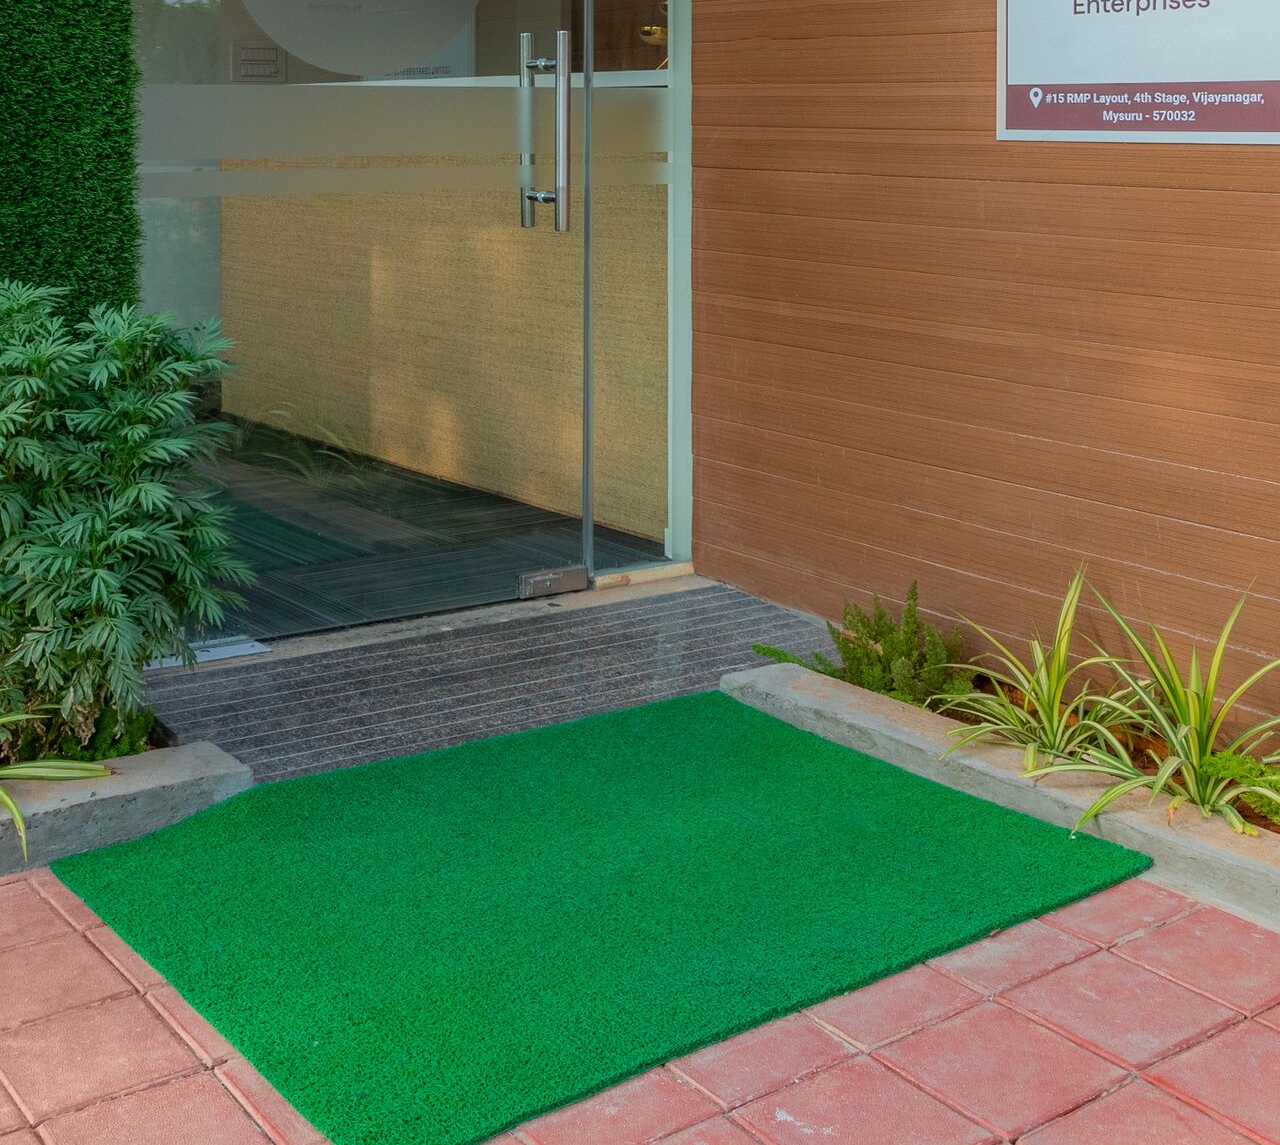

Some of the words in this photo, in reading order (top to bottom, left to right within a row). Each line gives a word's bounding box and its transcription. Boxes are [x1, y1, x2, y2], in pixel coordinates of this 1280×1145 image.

[1045, 93, 1065, 103] #15
[1067, 93, 1091, 103] RMP
[1093, 93, 1131, 105] Layout,
[1133, 92, 1152, 103] 4th
[1154, 92, 1189, 106] Stage,
[1192, 91, 1265, 105] Vijayanagar,
[1102, 110, 1143, 123] Mysuru
[1152, 110, 1196, 122] 570032
